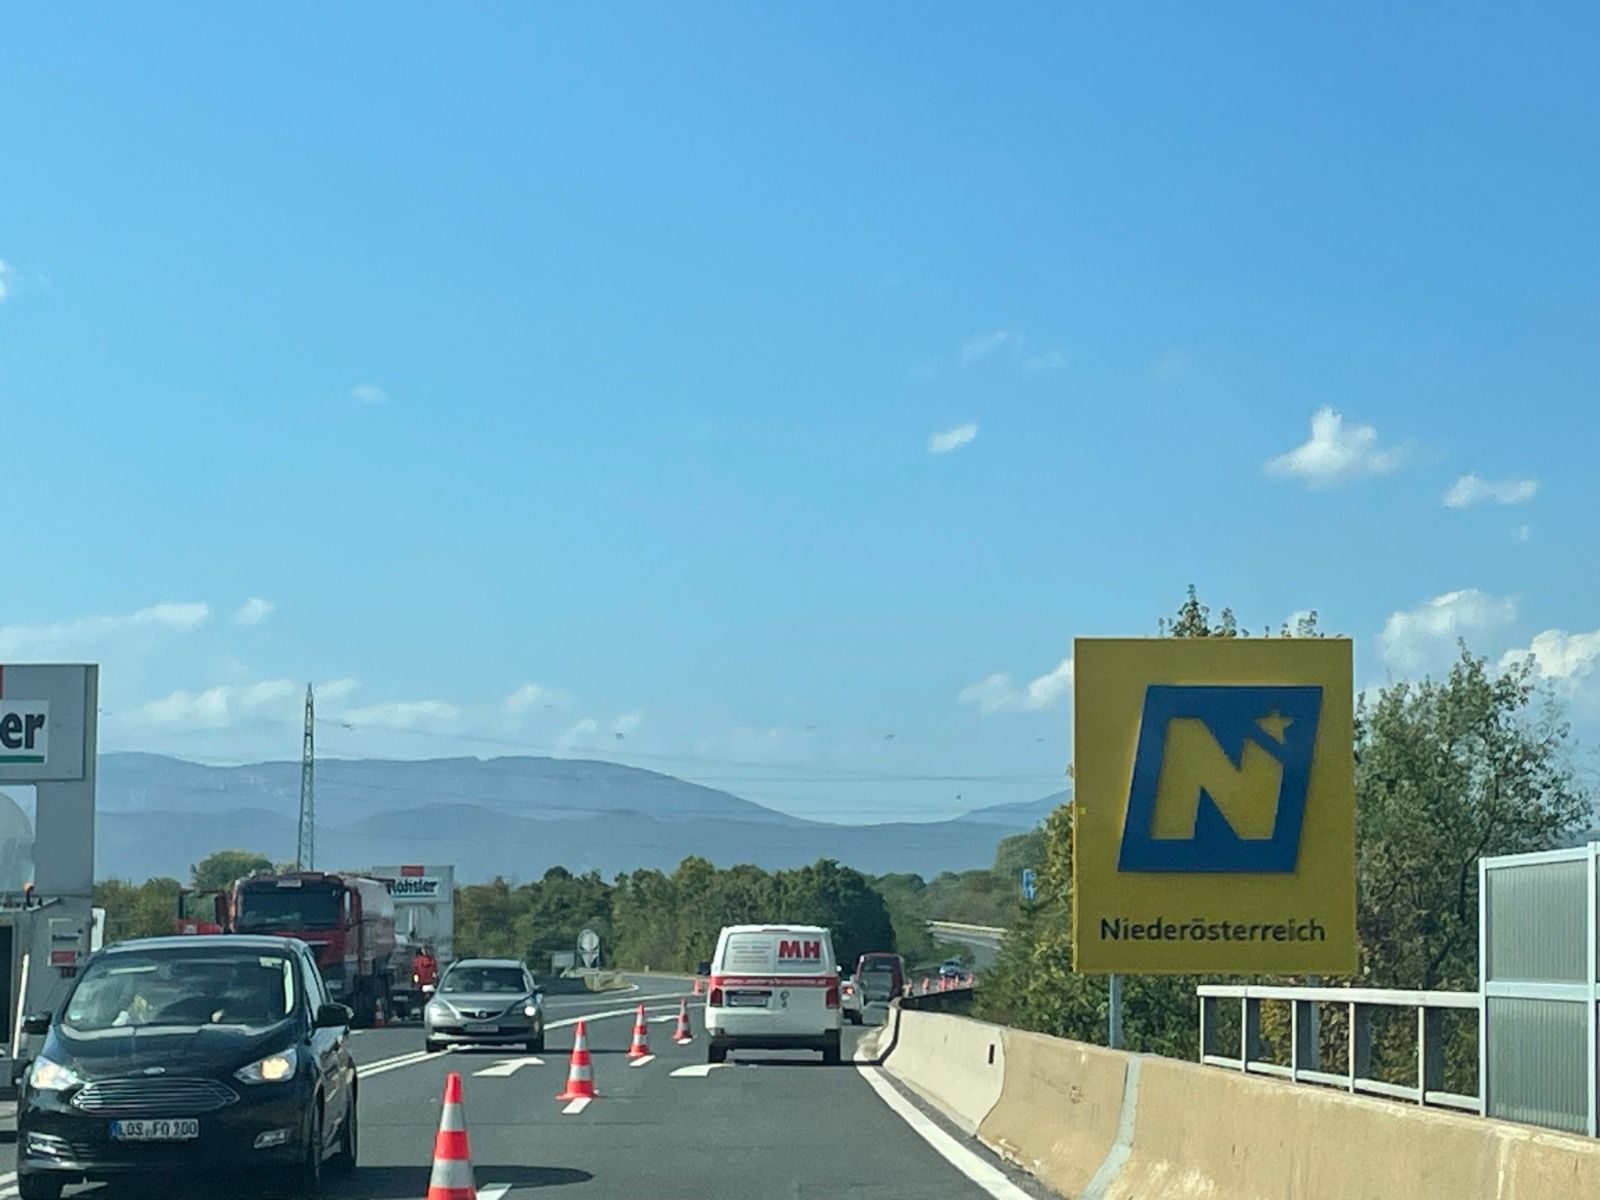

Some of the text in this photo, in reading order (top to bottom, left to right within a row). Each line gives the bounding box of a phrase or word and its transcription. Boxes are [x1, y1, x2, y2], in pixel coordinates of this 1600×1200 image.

[0, 712, 46, 750] er
[1100, 917, 1325, 942] Niederösterreich
[778, 940, 821, 959] MH
